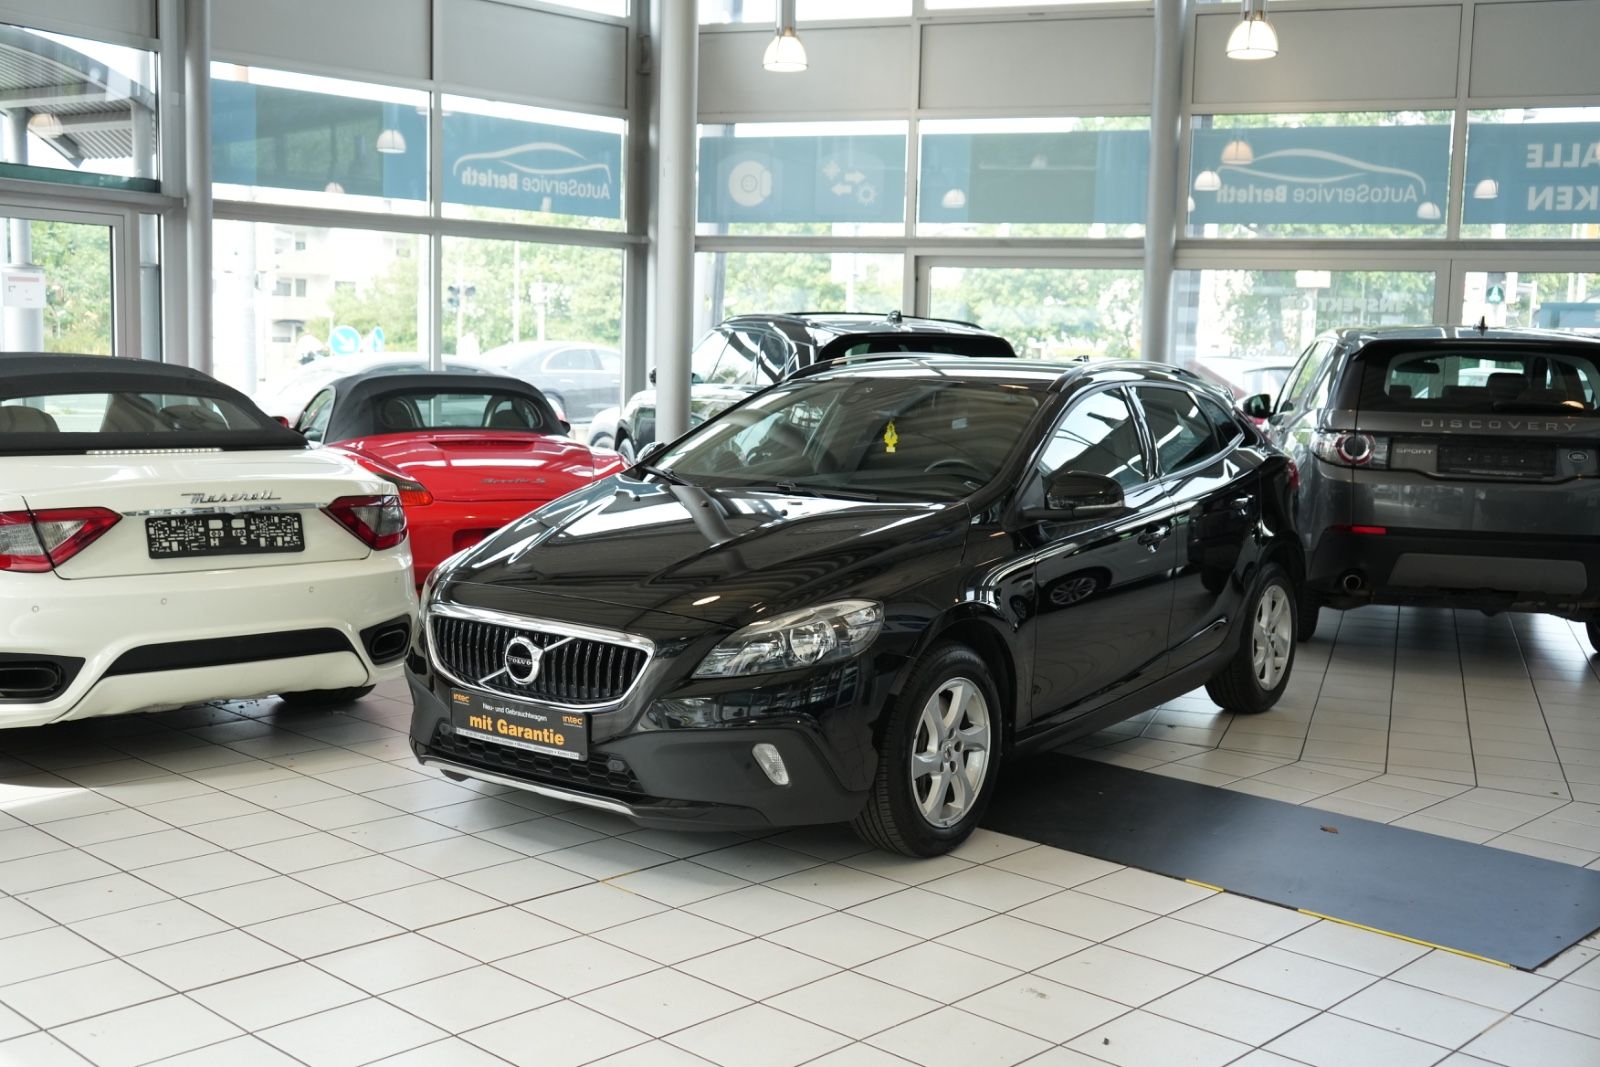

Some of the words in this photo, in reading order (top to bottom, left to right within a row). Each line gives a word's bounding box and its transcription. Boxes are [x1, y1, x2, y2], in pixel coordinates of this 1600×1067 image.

[1420, 418, 1576, 431] DISCOVERY
[180, 490, 281, 504] Maserati
[562, 715, 583, 726] intec
[469, 714, 493, 731] mit
[497, 719, 565, 746] Garantie
